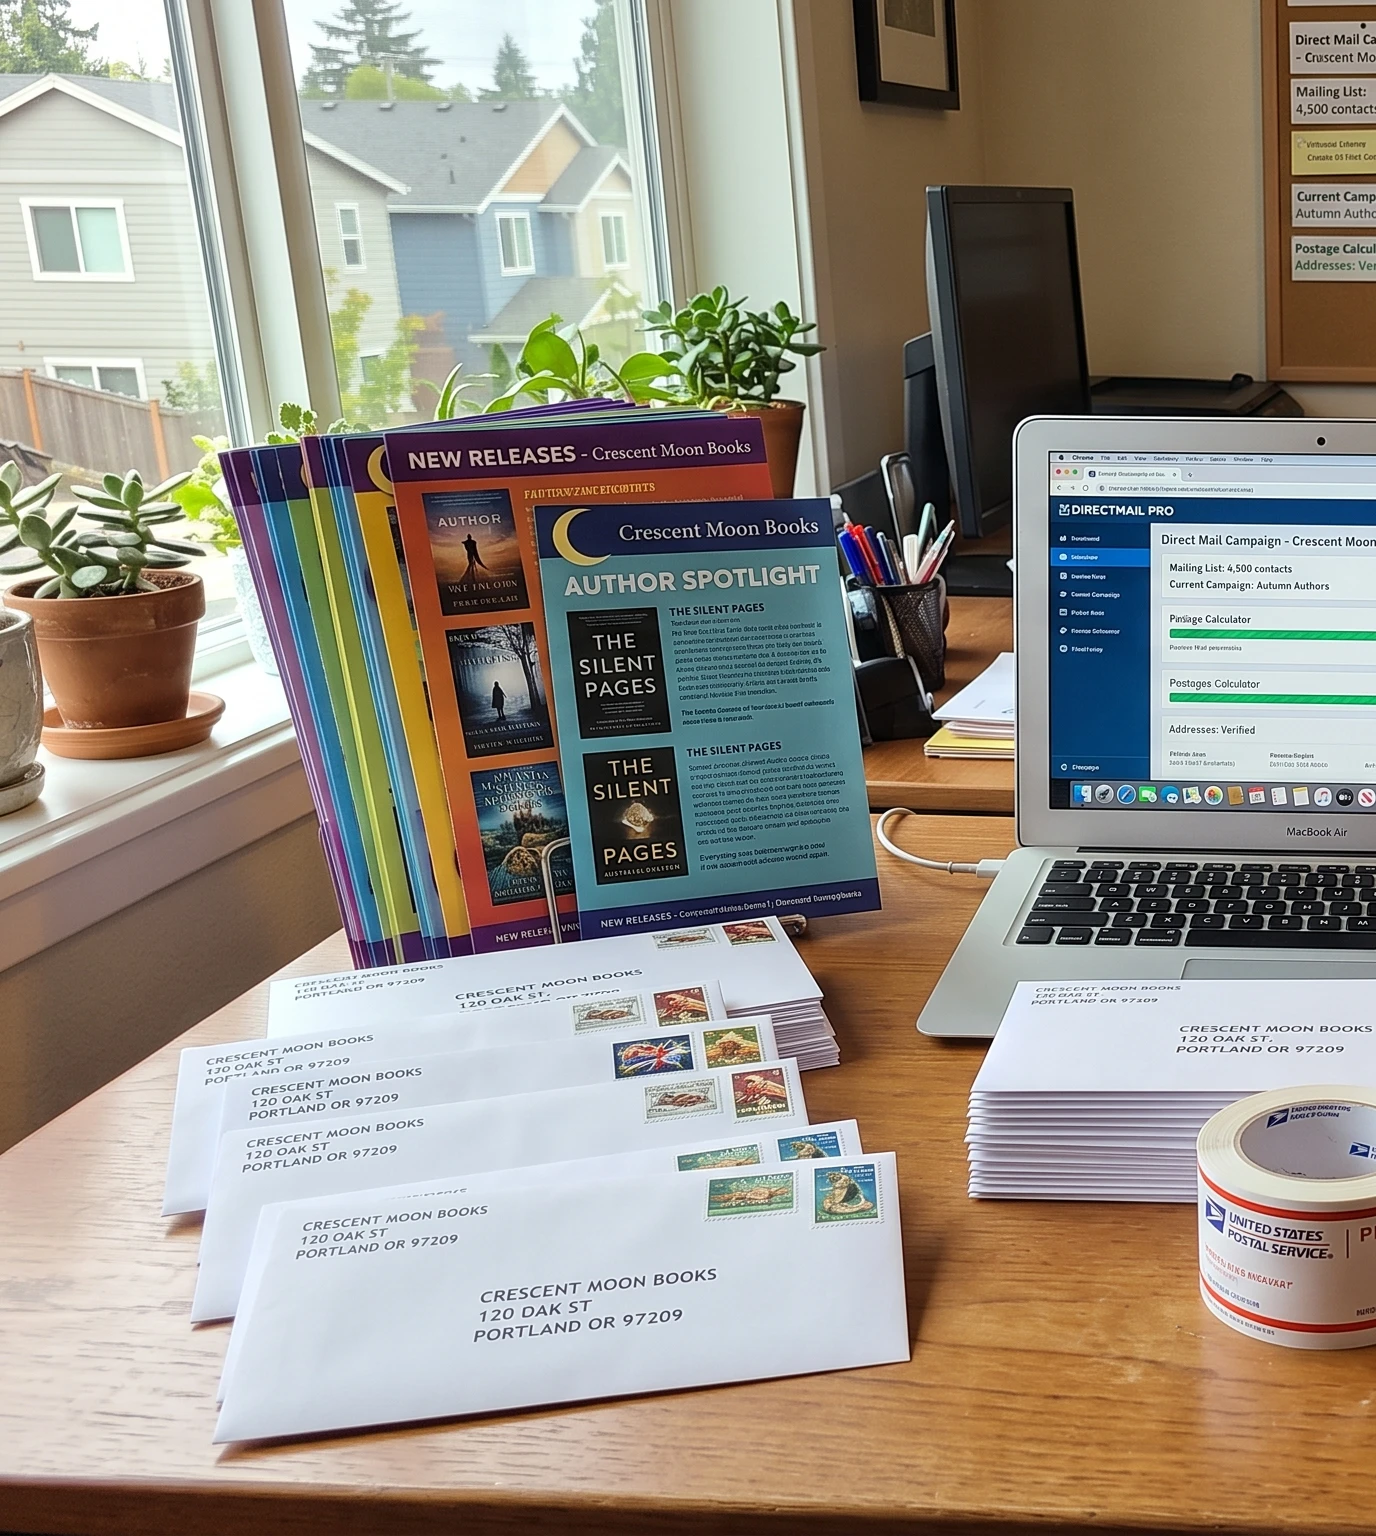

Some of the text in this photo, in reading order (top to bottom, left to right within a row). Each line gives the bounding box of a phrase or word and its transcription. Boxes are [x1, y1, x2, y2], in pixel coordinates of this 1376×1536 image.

[1295, 34, 1330, 45] Direct
[1334, 34, 1359, 45] Mail
[1296, 86, 1340, 99] Mailing
[1296, 104, 1328, 116] 4,500
[1297, 191, 1341, 202] Current
[1295, 208, 1341, 219] Autumn
[1295, 243, 1340, 256] Postage
[1295, 260, 1356, 271] Addresses:
[408, 440, 751, 470] NEW RELEASES Crescent Moon Books
[1072, 505, 1174, 516] DIRECTMAIL PRO
[437, 514, 502, 528] AUTHOR
[618, 516, 819, 543] Crescent Moon Books
[1161, 534, 1196, 546] Direct
[1199, 534, 1223, 546] Mail
[1226, 535, 1281, 549] Campaign
[1292, 537, 1342, 547] Crescent
[1345, 537, 1376, 547] Moon
[1170, 563, 1292, 574] Mailing List: 4,500 contacts
[563, 563, 820, 597] AUTHOR SPOTLIGHT
[1170, 580, 1330, 591] Current Campaign: Autumn Authors
[669, 602, 765, 617] THE SILENT PAGES
[1205, 615, 1251, 624] Calculator
[592, 633, 636, 650] THE
[579, 655, 657, 676] SILENT
[585, 678, 657, 698] PAGES
[1169, 679, 1211, 690] Postages
[1169, 725, 1256, 735] Addresses: Verified
[687, 741, 782, 758] THE SILENT PAGES
[607, 758, 653, 777] THE
[593, 778, 672, 800] SILENT
[1286, 827, 1348, 837] MacBook Air
[603, 842, 678, 865] PAGES
[601, 912, 672, 928] NEW RELEASES
[1179, 1025, 1373, 1033] CRESCENT MOON BOOKS
[1180, 1035, 1208, 1043] 120
[1212, 1035, 1246, 1043] OAK
[1176, 1045, 1344, 1054] PORTLAND OR 97209
[251, 1068, 422, 1096] CRESCENT MOON BOOKS
[249, 1093, 399, 1121] PORTLAND OR 97209
[246, 1119, 425, 1148] CRESCENT MOON BOOKS
[242, 1145, 397, 1173] PORTLAND OR 97209
[302, 1206, 488, 1231] CRESCENT MOON BOOKS
[1229, 1212, 1324, 1241] UNITED STATES
[301, 1228, 389, 1245] 120 OAK ST
[1228, 1230, 1270, 1252] POSTAL
[295, 1234, 458, 1260] PORTLAND OR 97209
[480, 1268, 717, 1304] CRESCENT MOON BOOKS
[479, 1307, 515, 1323] 120
[568, 1299, 593, 1313] ST
[473, 1309, 683, 1342] PORTLAND OR 97209
